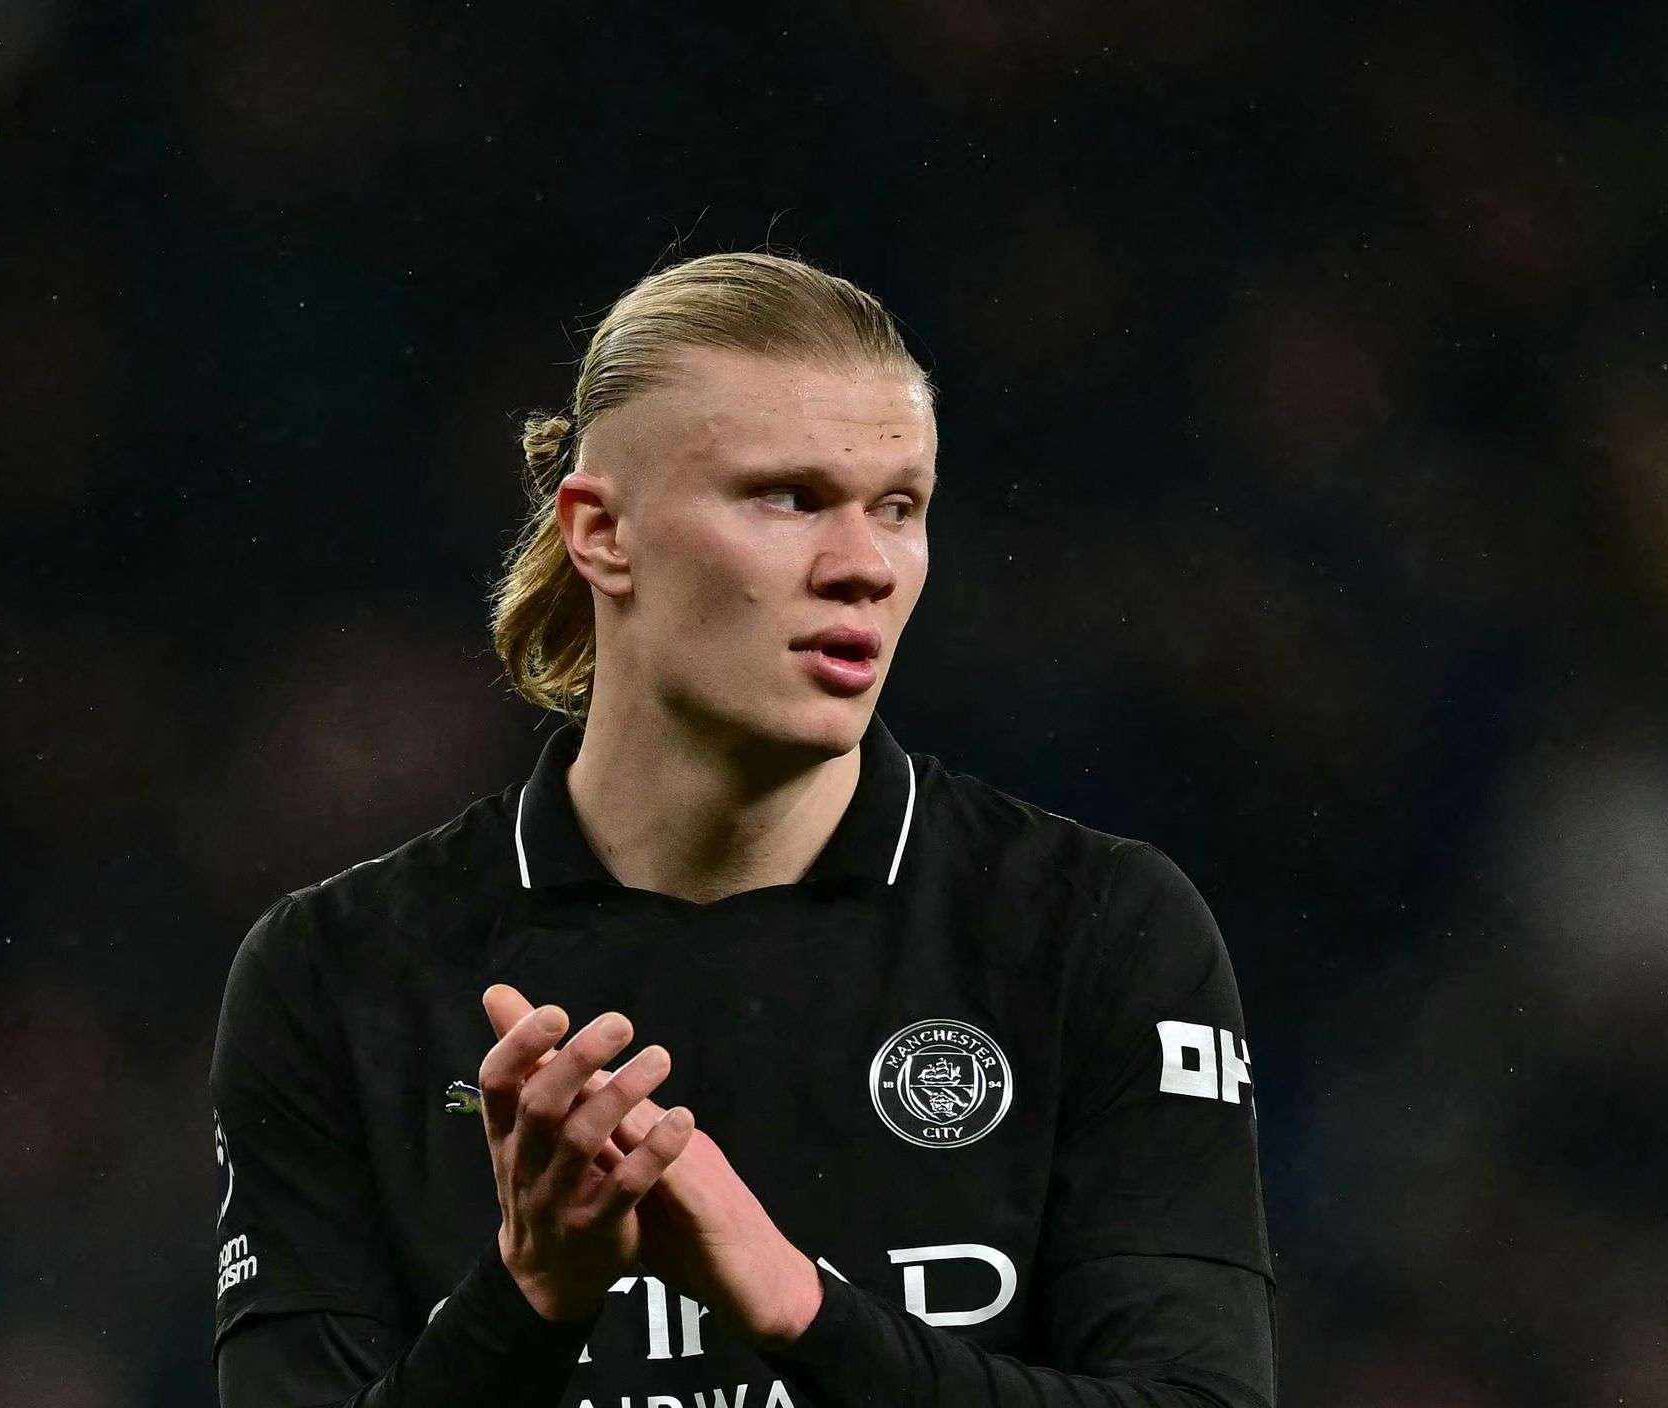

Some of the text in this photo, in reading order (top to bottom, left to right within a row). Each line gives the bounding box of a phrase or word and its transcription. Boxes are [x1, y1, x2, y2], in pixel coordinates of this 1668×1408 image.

[886, 1029, 997, 1069] MANCHESTER
[1155, 1020, 1257, 1120] OK
[988, 1080, 1002, 1089] 94
[922, 1126, 964, 1139] CITY
